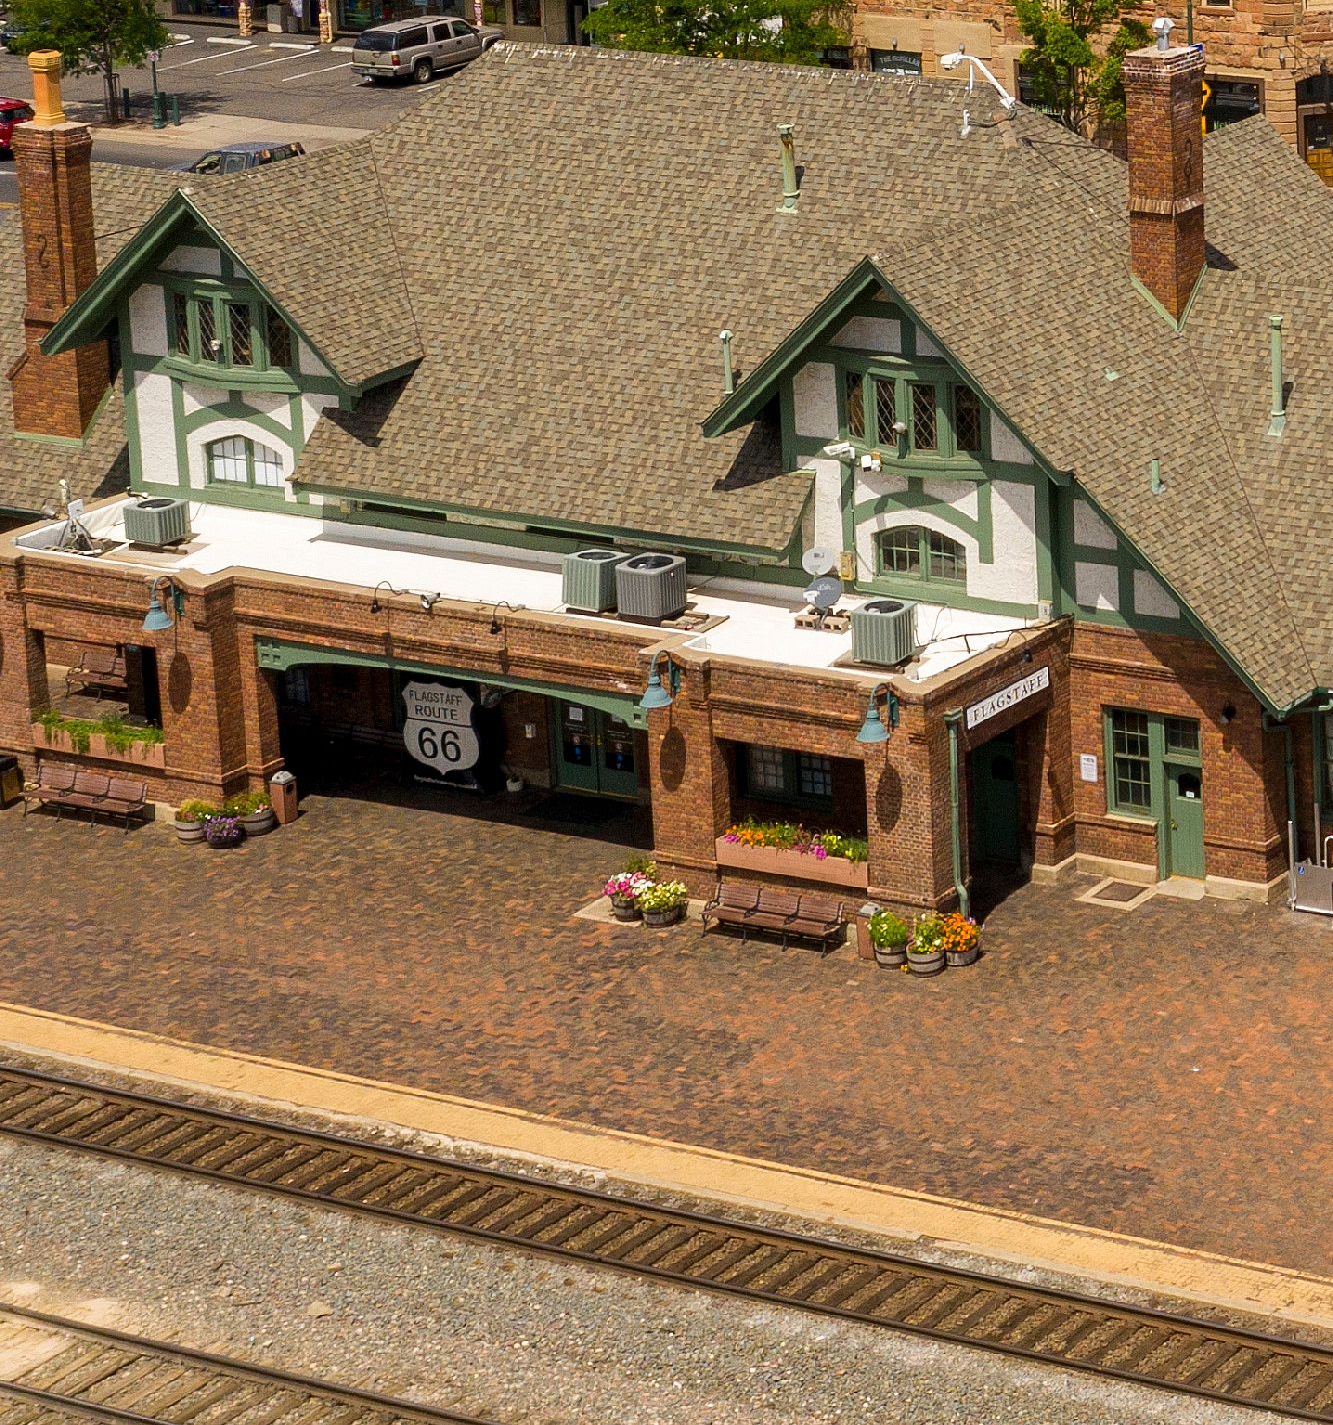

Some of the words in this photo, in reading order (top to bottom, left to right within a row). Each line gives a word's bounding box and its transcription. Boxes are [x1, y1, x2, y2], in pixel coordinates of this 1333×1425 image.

[409, 689, 463, 707] FLAGSTAFF
[972, 675, 1043, 722] FLAGSTAFF
[414, 704, 459, 721] ROUTE
[418, 726, 462, 762] 66
